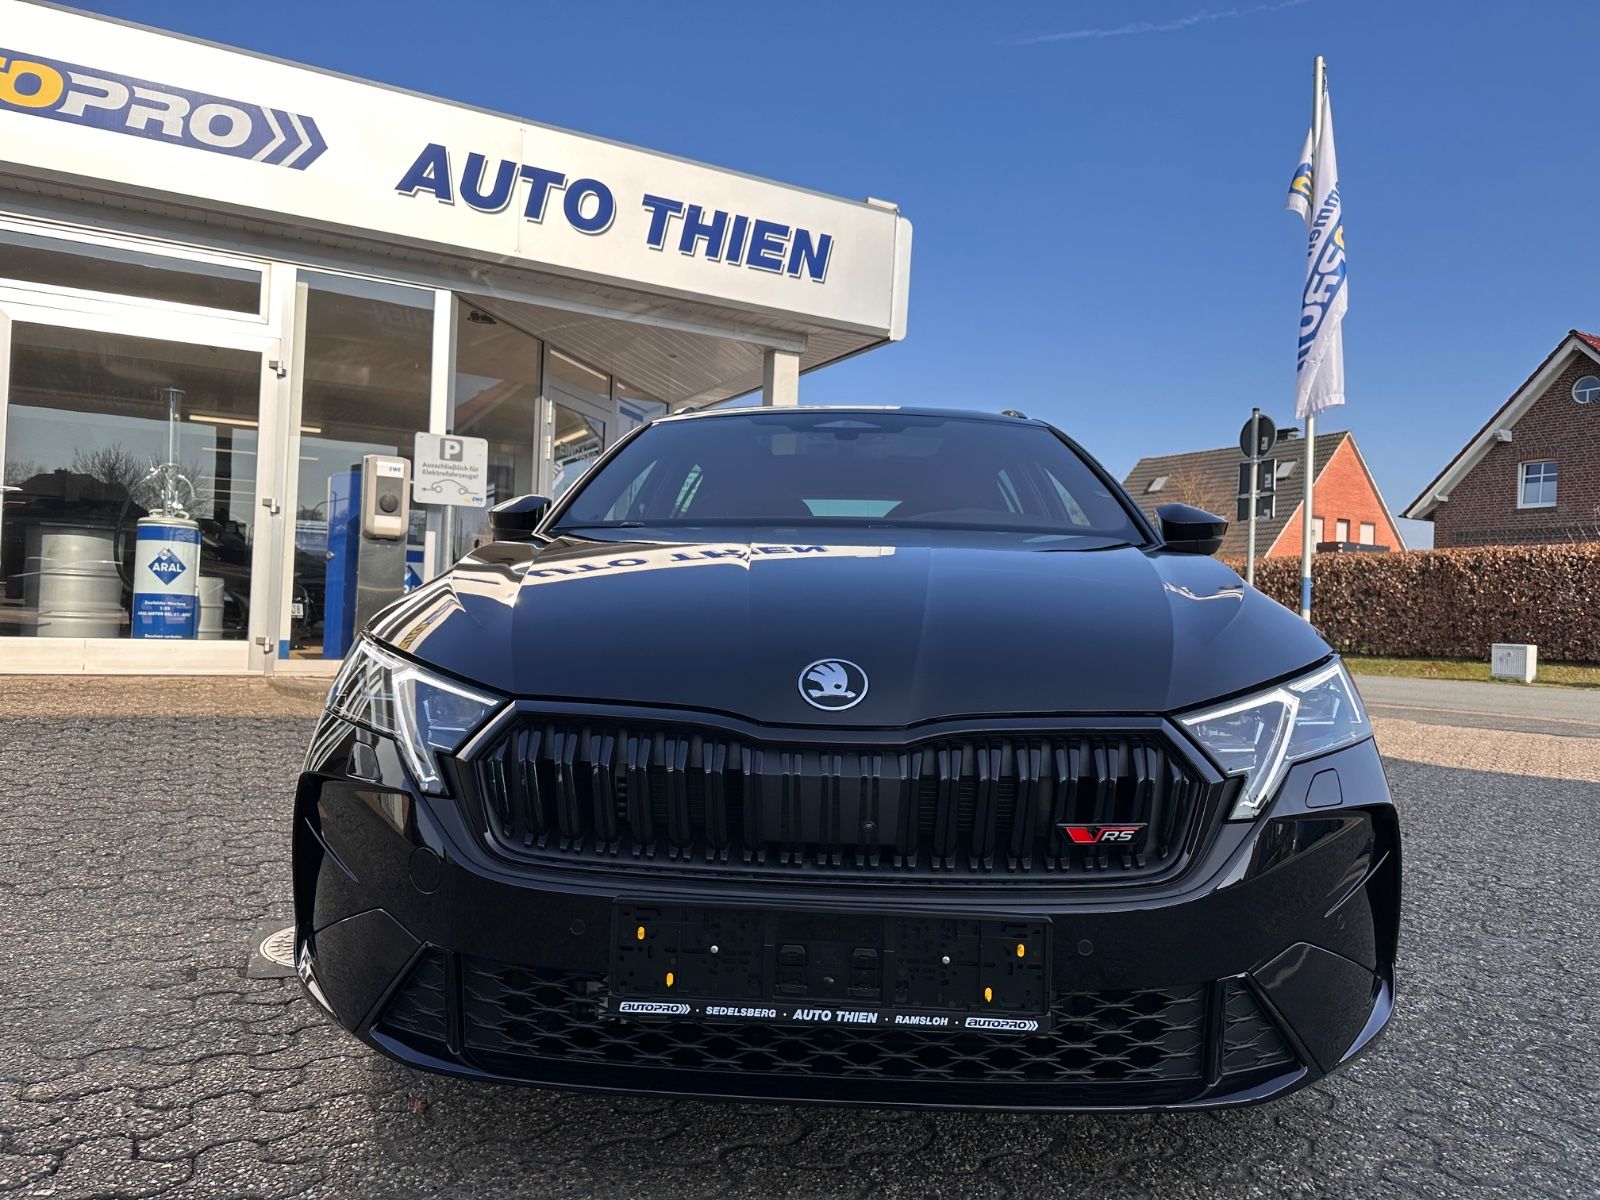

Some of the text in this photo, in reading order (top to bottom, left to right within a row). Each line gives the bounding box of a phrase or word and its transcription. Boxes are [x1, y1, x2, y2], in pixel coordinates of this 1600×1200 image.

[395, 143, 833, 282] AUTO THIEN
[444, 440, 460, 460] P
[422, 462, 468, 471] Ausschließlich
[152, 563, 182, 572] ARAL
[705, 1006, 777, 1018] SEDELSBERG
[792, 1009, 832, 1021] AUTO
[836, 1011, 878, 1023] THIEN
[895, 1015, 948, 1025] RAMSLOH
